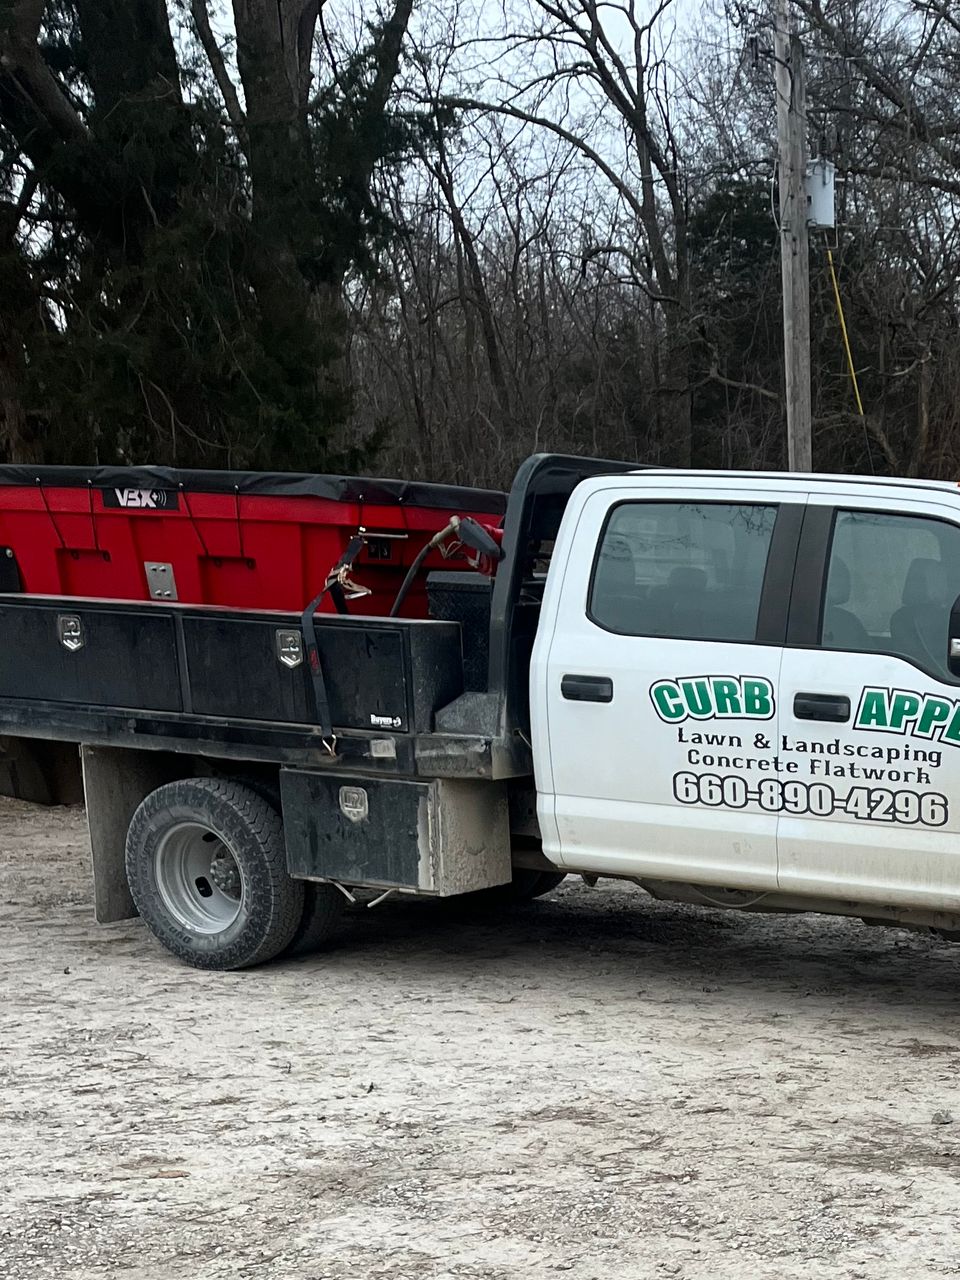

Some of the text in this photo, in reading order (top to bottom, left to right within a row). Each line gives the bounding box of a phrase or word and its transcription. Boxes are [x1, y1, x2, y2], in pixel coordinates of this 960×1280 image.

[649, 675, 776, 724] CURB
[677, 726, 942, 767] Lawn & Landscaping
[687, 748, 931, 784] Concrete Flatwork
[672, 770, 949, 828] 660-890-4296
